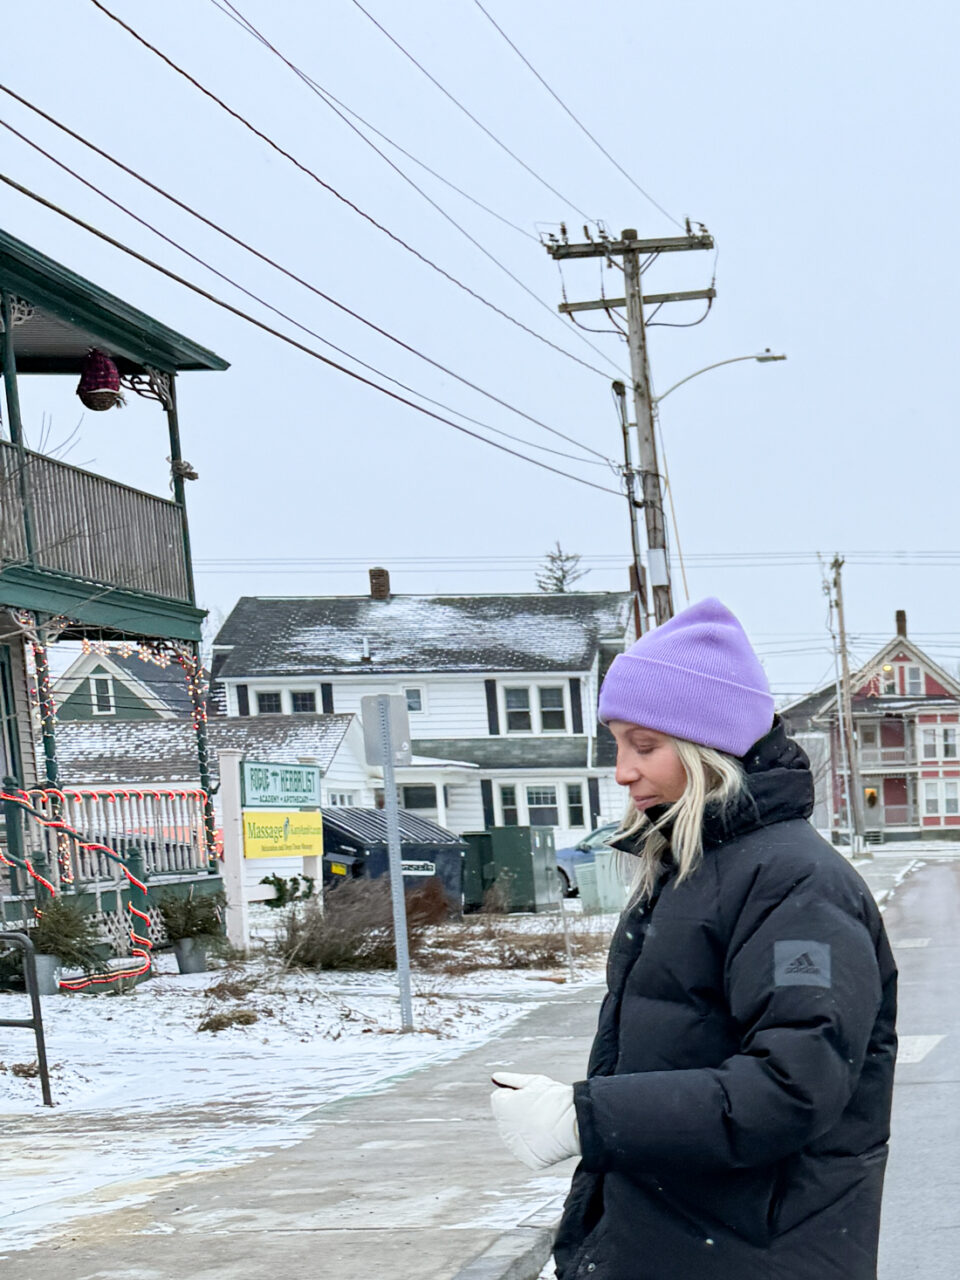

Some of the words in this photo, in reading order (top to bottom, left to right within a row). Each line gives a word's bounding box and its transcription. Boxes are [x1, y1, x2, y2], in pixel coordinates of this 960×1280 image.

[250, 767, 270, 792] ROGUE
[280, 769, 315, 793] HERBALIST
[248, 822, 283, 843] Massage
